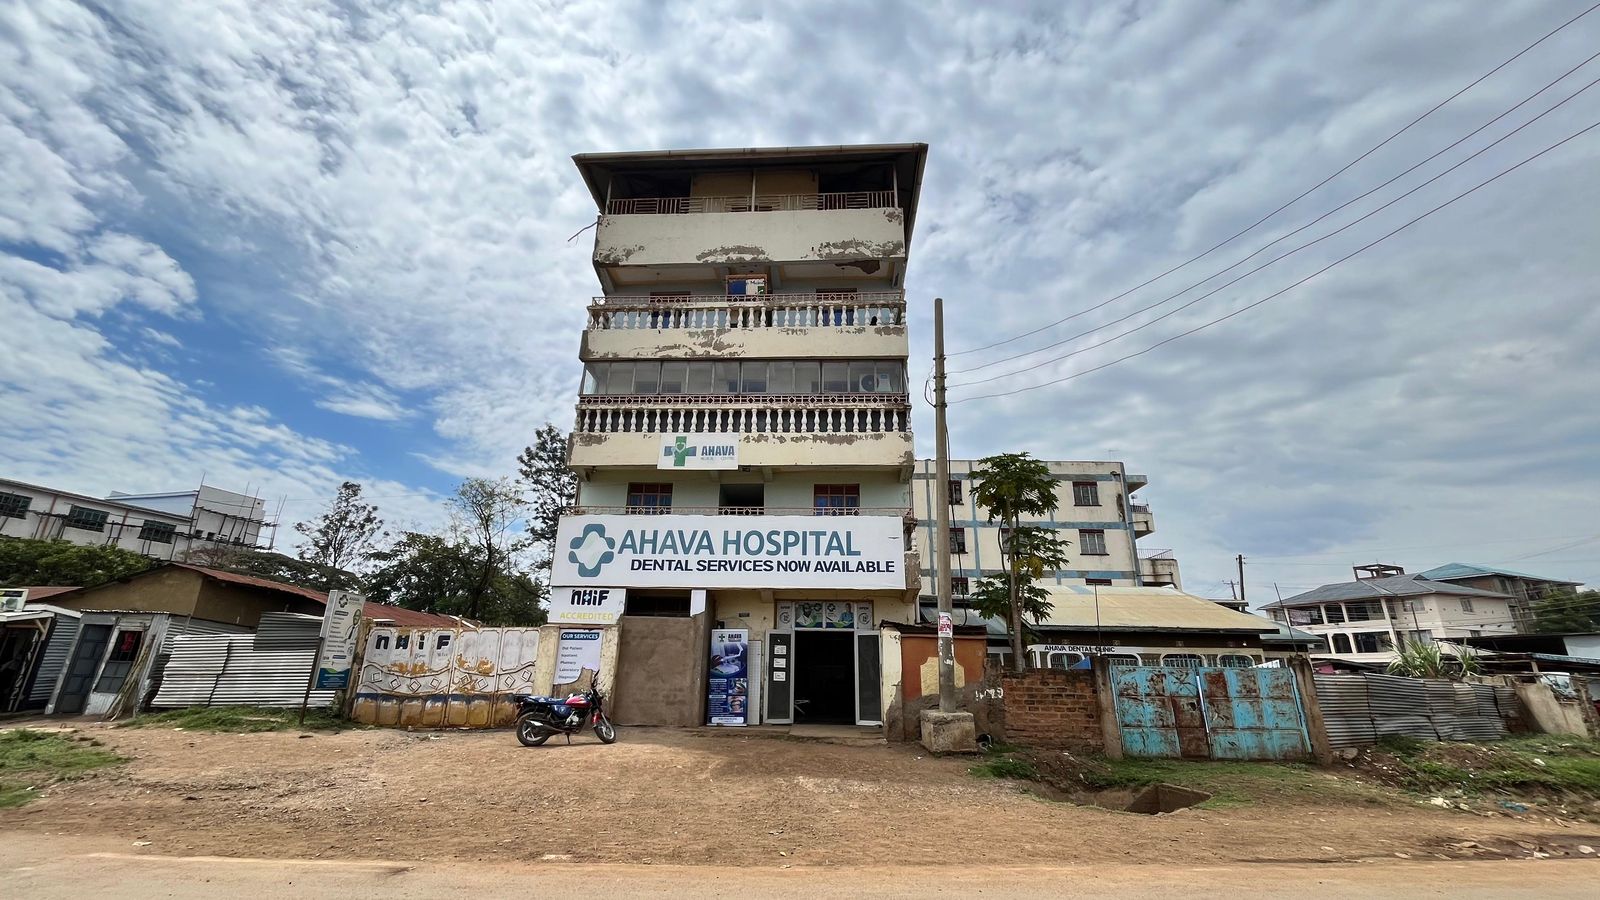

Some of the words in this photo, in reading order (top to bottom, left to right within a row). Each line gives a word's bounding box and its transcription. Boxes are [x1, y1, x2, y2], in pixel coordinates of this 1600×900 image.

[701, 446, 735, 456] AHAVA
[617, 530, 715, 555] AHAVA
[722, 530, 861, 556] HOSPITAL
[630, 559, 693, 571] DENTAL
[695, 559, 774, 572] SERVICES
[776, 560, 811, 572] NOW
[813, 560, 895, 573] AVAILABLE
[560, 612, 614, 620] ACCREDITED
[1068, 645, 1092, 653] DENTAL
